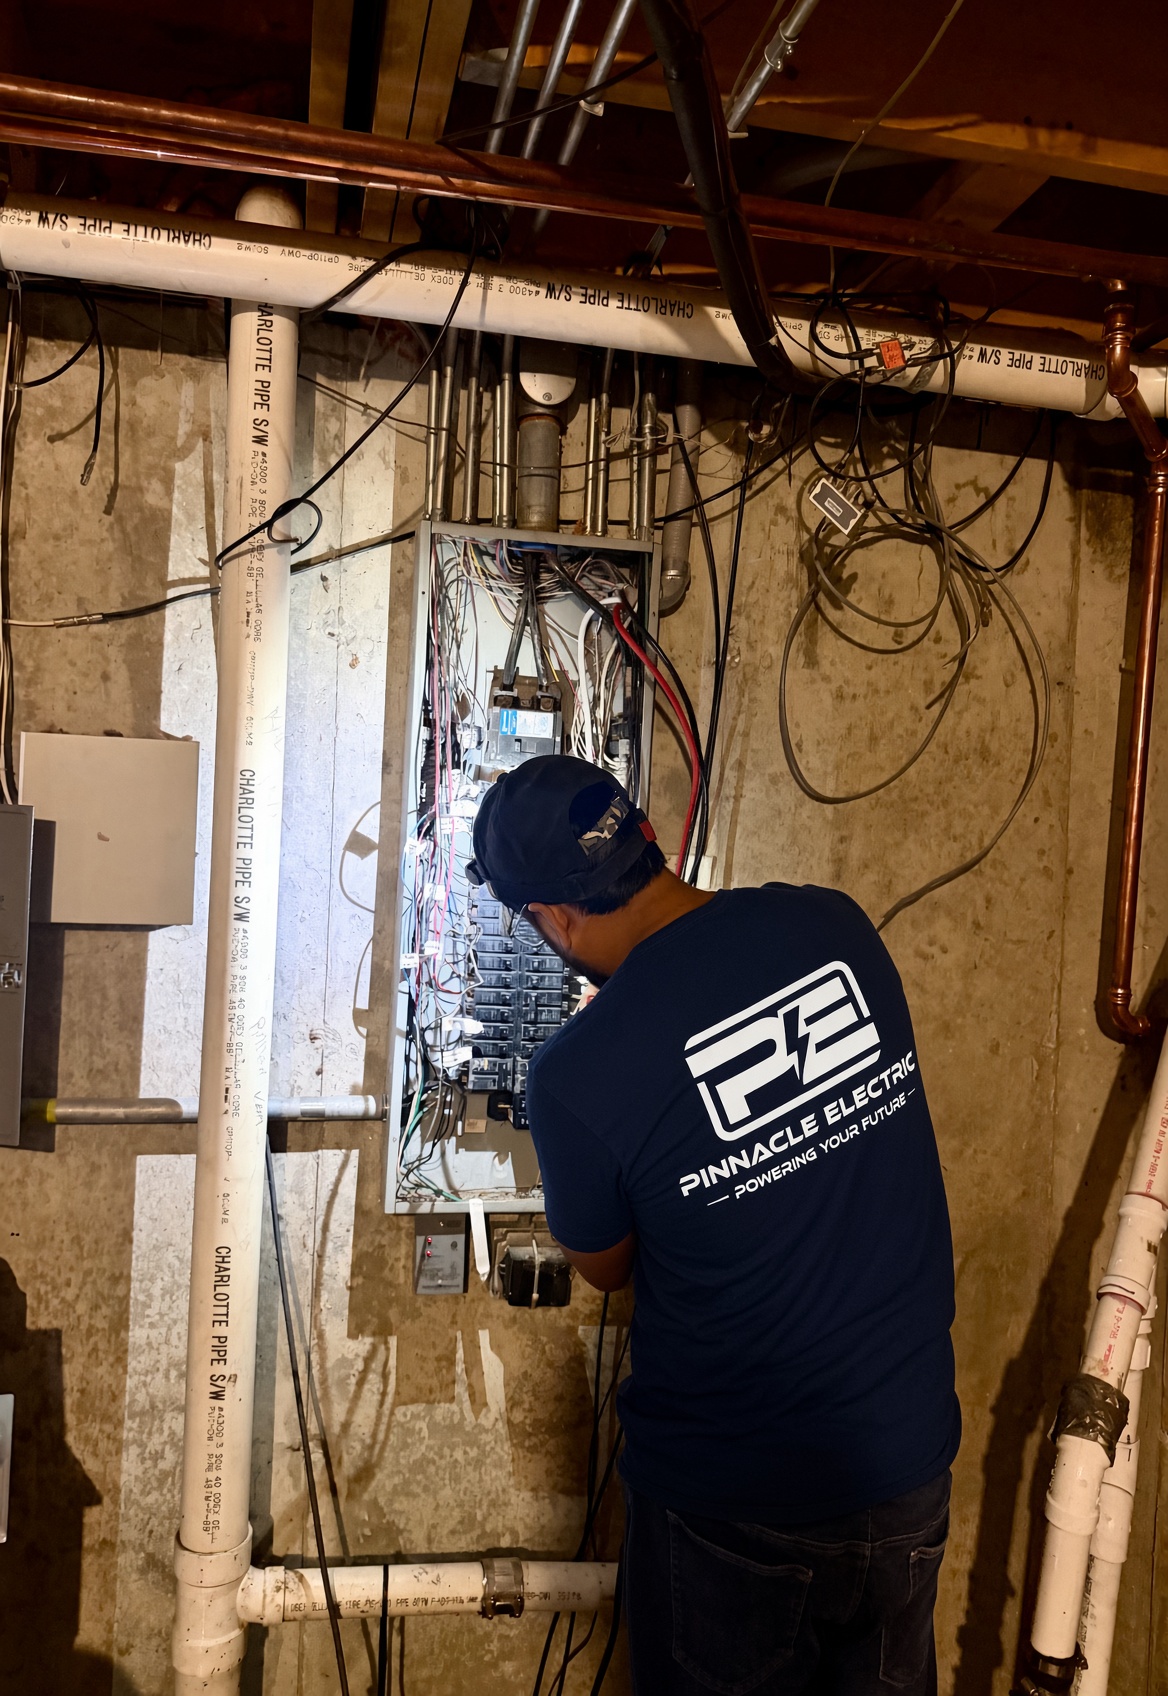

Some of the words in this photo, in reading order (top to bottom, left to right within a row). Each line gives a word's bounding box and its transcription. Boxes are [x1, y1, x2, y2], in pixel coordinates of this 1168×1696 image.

[37, 211, 69, 232] S/W
[77, 216, 113, 238] PIPE
[121, 221, 212, 250] CHARLOTTE
[544, 281, 572, 302] S/W
[579, 286, 610, 308] PIPE
[616, 292, 694, 319] CHARLOTTE
[255, 302, 274, 373] HARLOTTE
[976, 346, 1001, 366] S/W
[1006, 350, 1034, 371] PIPE
[1039, 355, 1106, 381] CHARLOTTE
[253, 379, 271, 412] PIPE
[251, 417, 270, 447] S/W
[236, 769, 256, 850] CHARLOTTE
[234, 857, 252, 888] PIPE
[233, 895, 251, 923] S/W
[679, 1113, 820, 1197] PINNACLE
[823, 1050, 916, 1125] ELECTRIC
[734, 1147, 818, 1199] POWERING
[819, 1123, 861, 1154] YOUR
[861, 1091, 907, 1132] FUTURE
[212, 1246, 232, 1328] CHARLOTTE
[210, 1335, 228, 1366] PIPE
[208, 1373, 226, 1401] S/W
